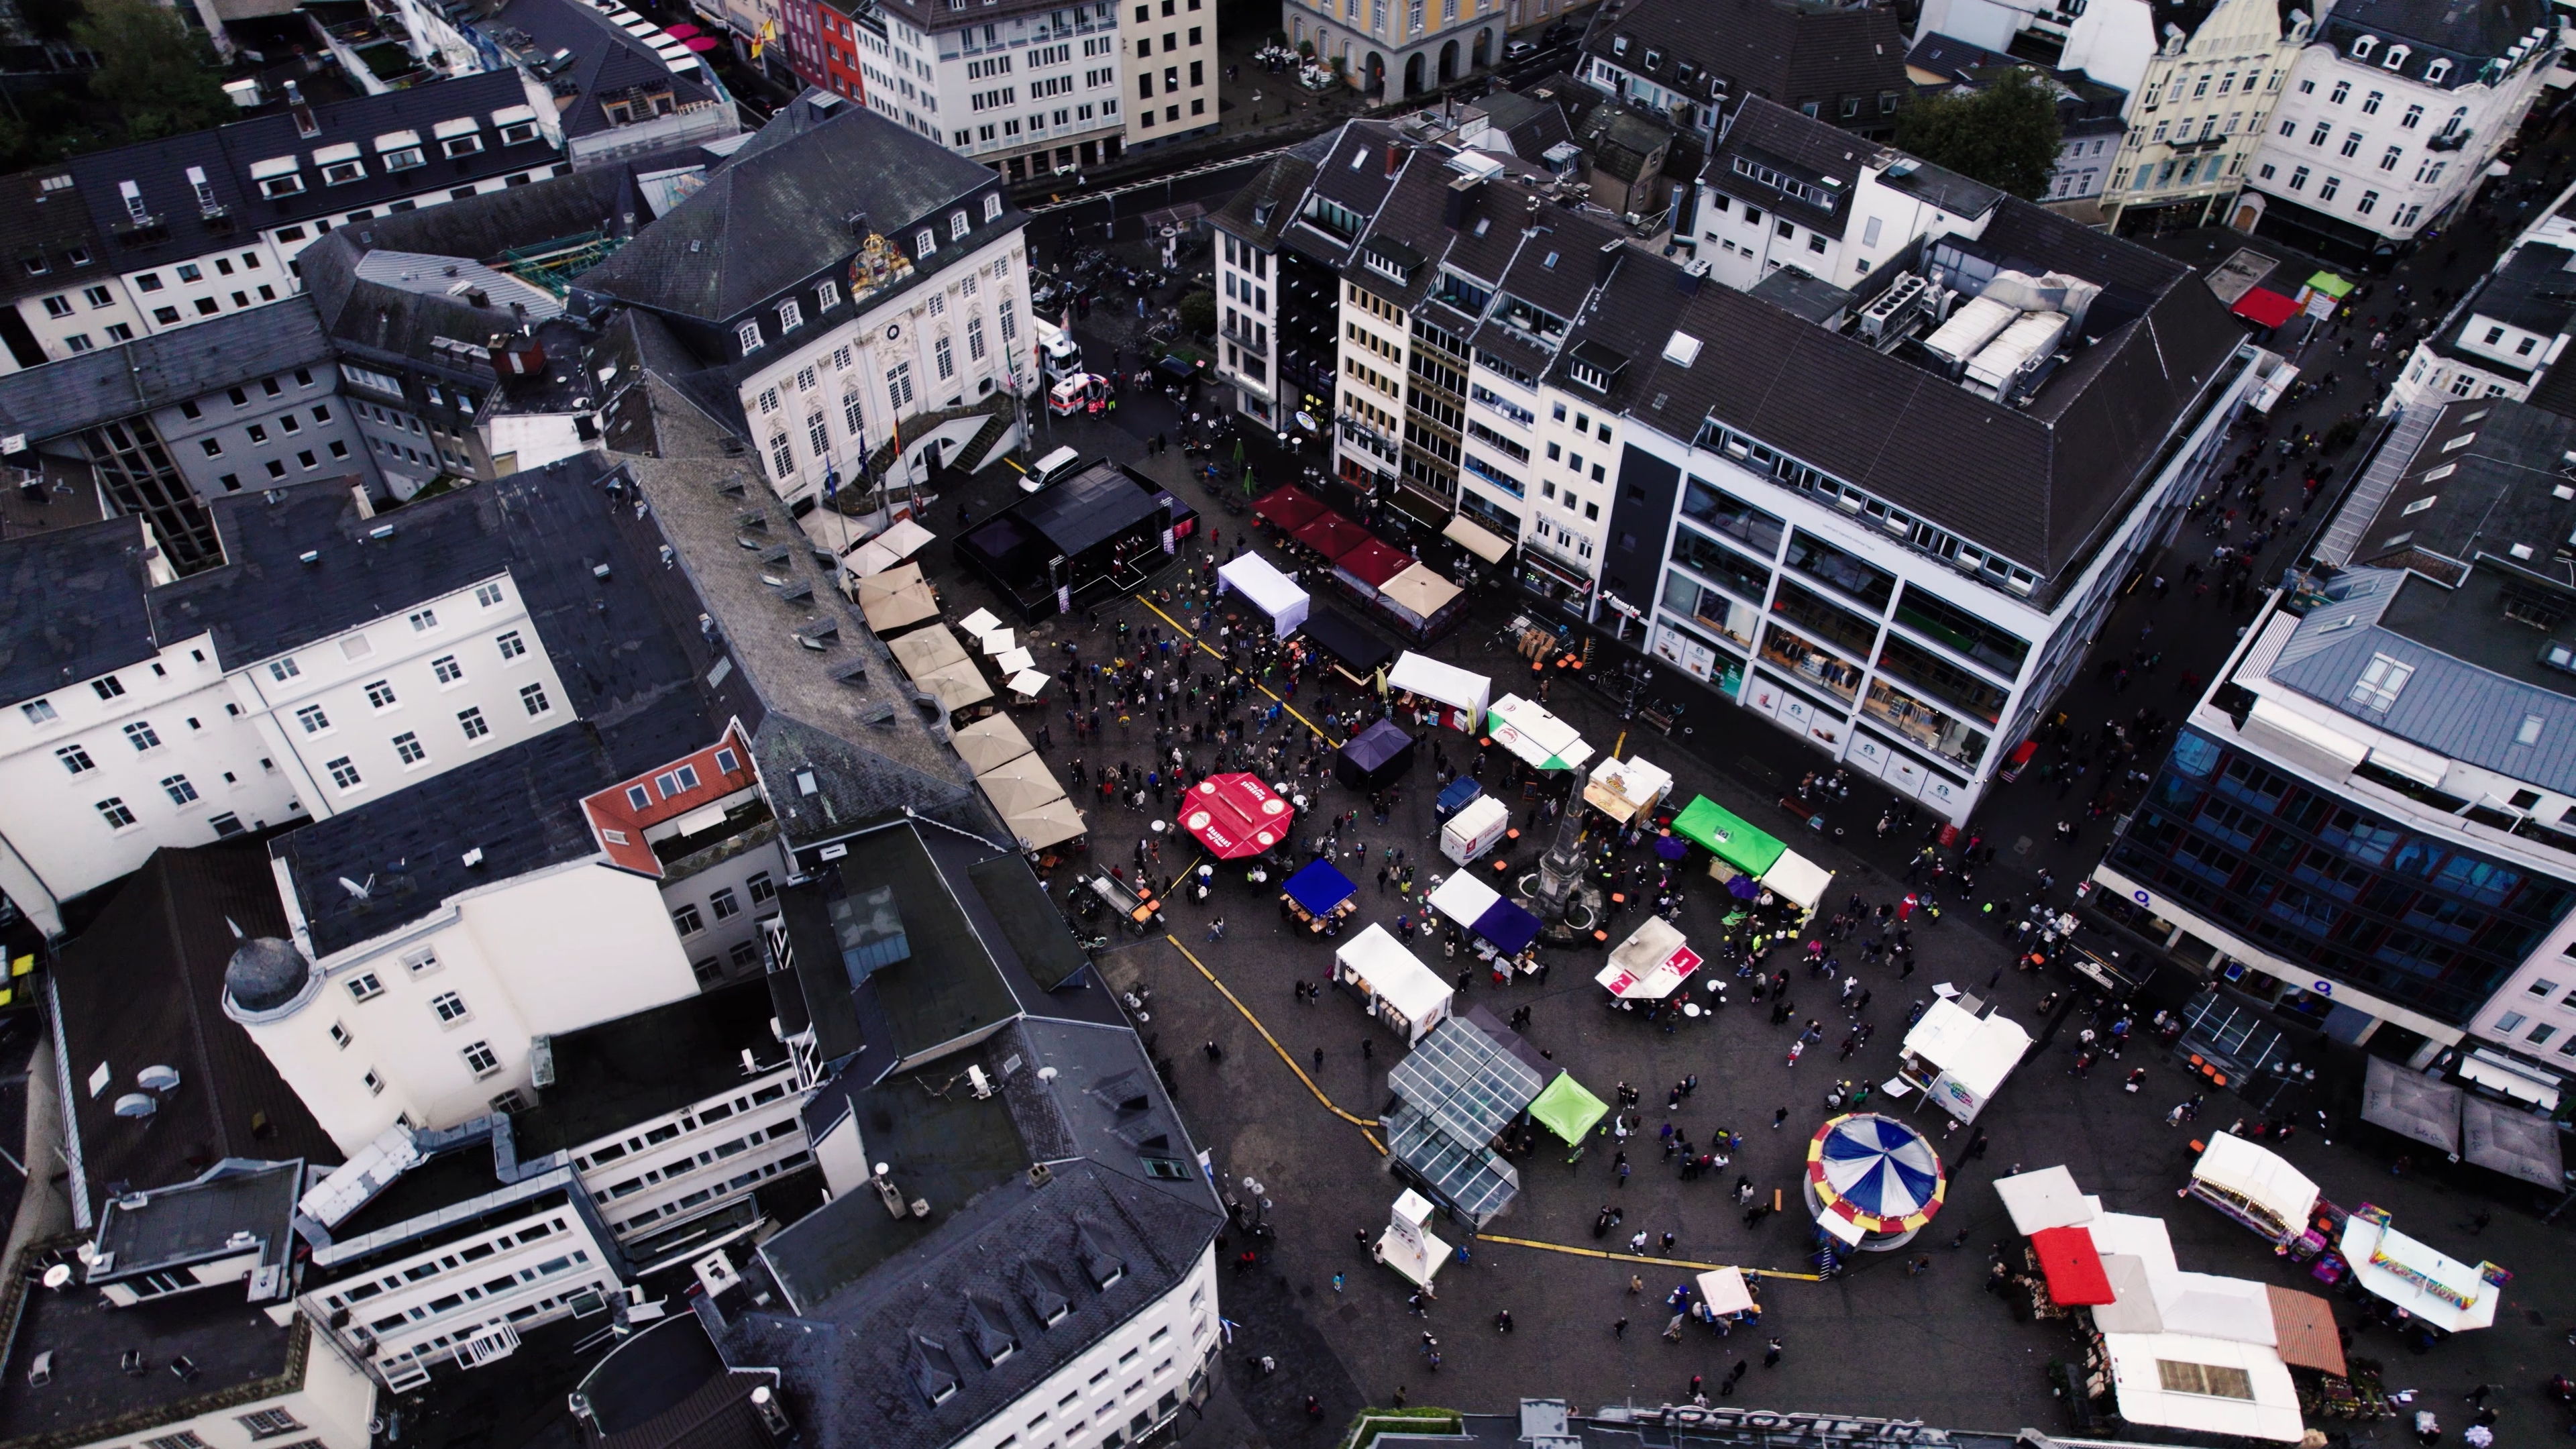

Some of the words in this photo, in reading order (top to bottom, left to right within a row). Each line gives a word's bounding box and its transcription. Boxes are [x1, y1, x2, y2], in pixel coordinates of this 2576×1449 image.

[1545, 515, 1580, 537] LEICA
[1240, 781, 1265, 801] BRAUHAUS
[1207, 826, 1232, 848] BRAUHAUS
[1214, 838, 1224, 847] Tour
[2096, 973, 2112, 985] FOOD
